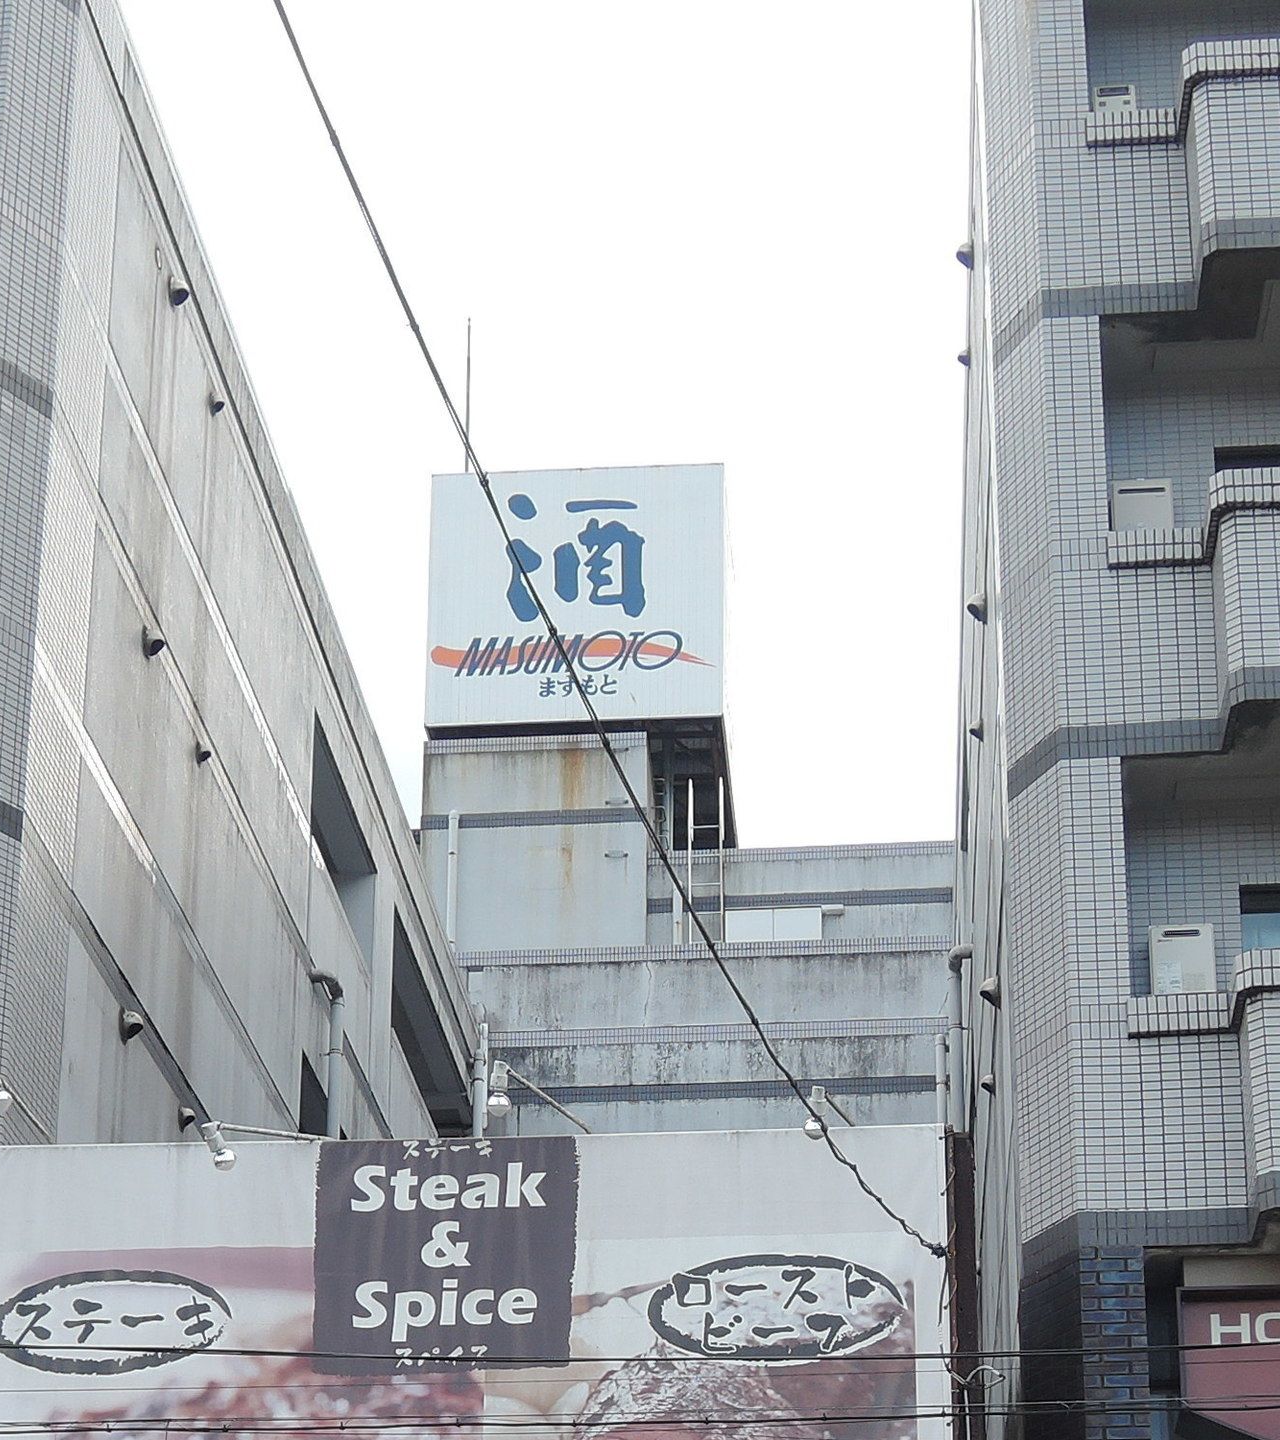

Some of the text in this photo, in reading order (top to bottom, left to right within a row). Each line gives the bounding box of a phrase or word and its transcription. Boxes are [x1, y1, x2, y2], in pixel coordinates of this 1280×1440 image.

[455, 631, 682, 677] MASUMOTO
[539, 676, 617, 697] ますもと
[403, 1140, 493, 1160] ステーキ
[351, 1162, 547, 1211] Steak
[421, 1221, 471, 1268] &
[672, 1264, 876, 1310] ロースト
[15, 1296, 214, 1345] ステーキ
[352, 1279, 538, 1342] Spice
[702, 1312, 848, 1353] ビーフ
